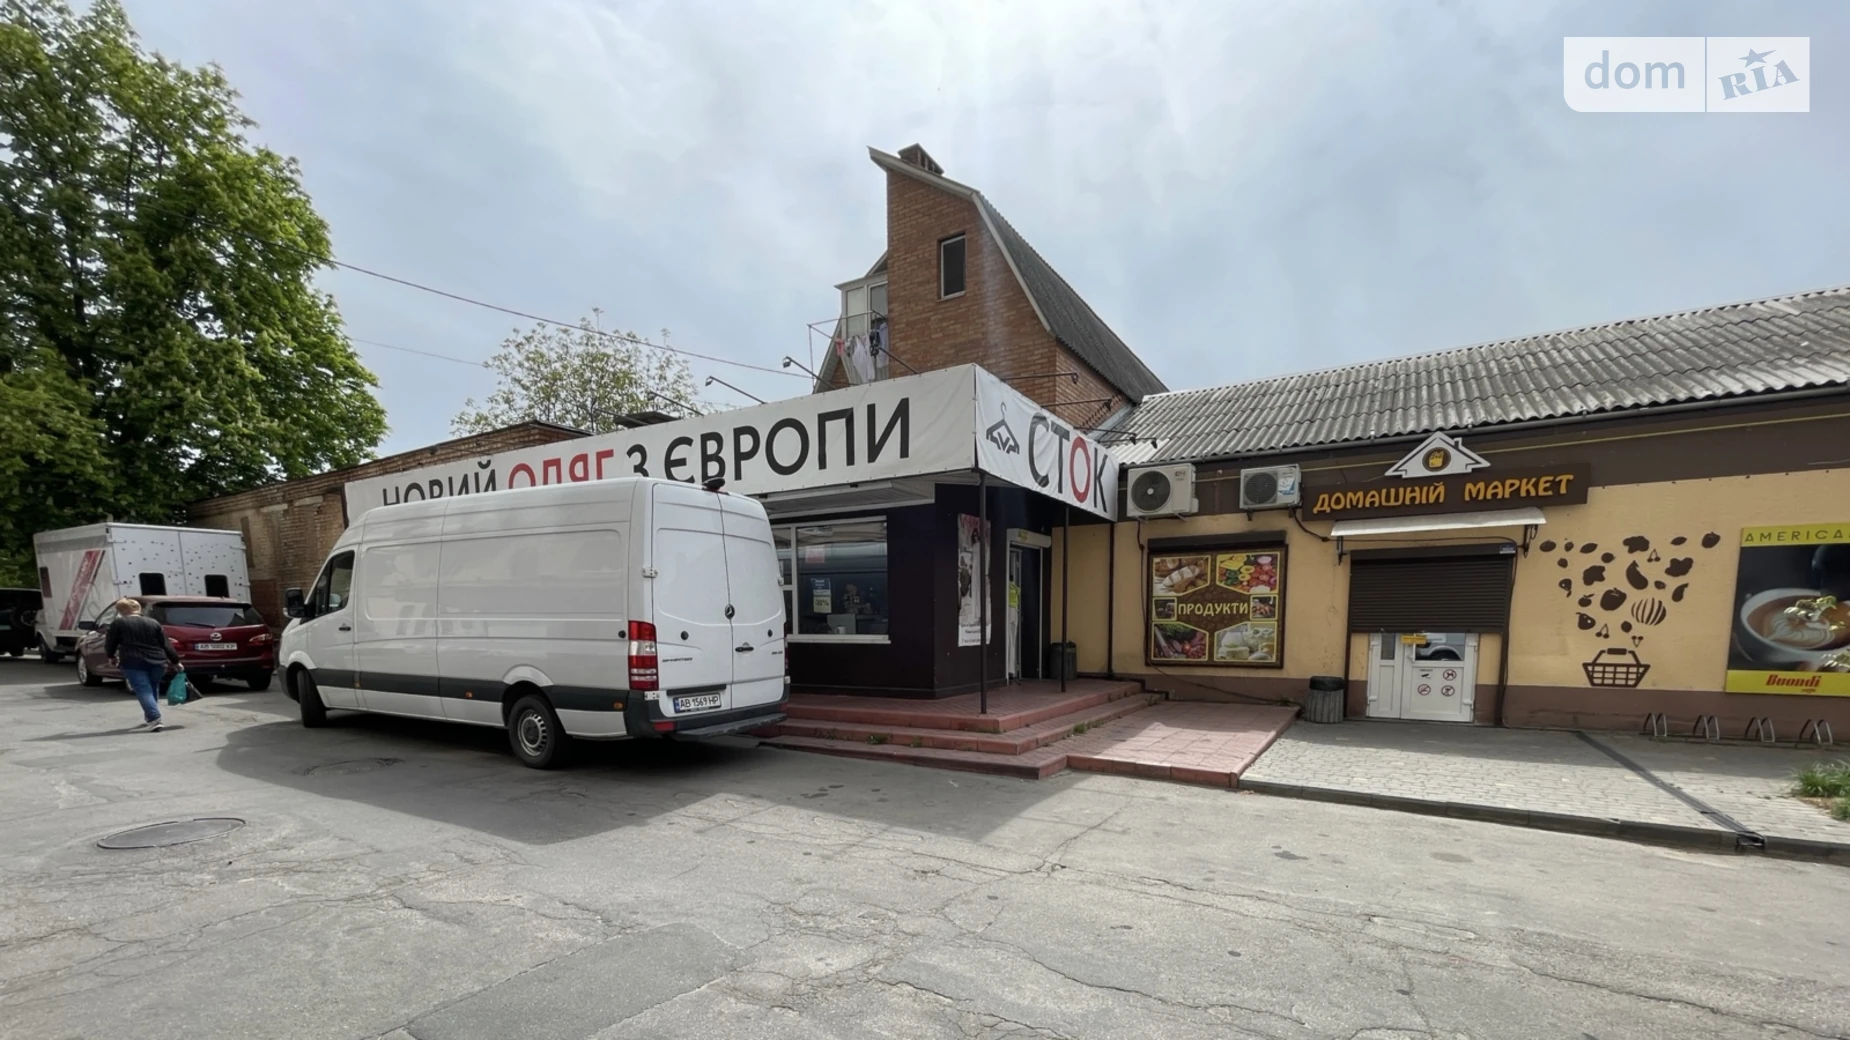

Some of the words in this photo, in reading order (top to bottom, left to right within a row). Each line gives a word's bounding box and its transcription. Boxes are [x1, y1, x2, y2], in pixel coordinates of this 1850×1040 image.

[664, 397, 910, 484] ЄВРОПИ
[1028, 412, 1109, 514] СТОК
[1312, 481, 1446, 514] ДОМАШНІЙ
[1464, 473, 1574, 502] МАРКЕТ
[1744, 529, 1850, 542] AMERICA
[1177, 602, 1249, 617] ПРОДУКТИ
[680, 698, 691, 708] AB
[692, 696, 708, 707] 1569
